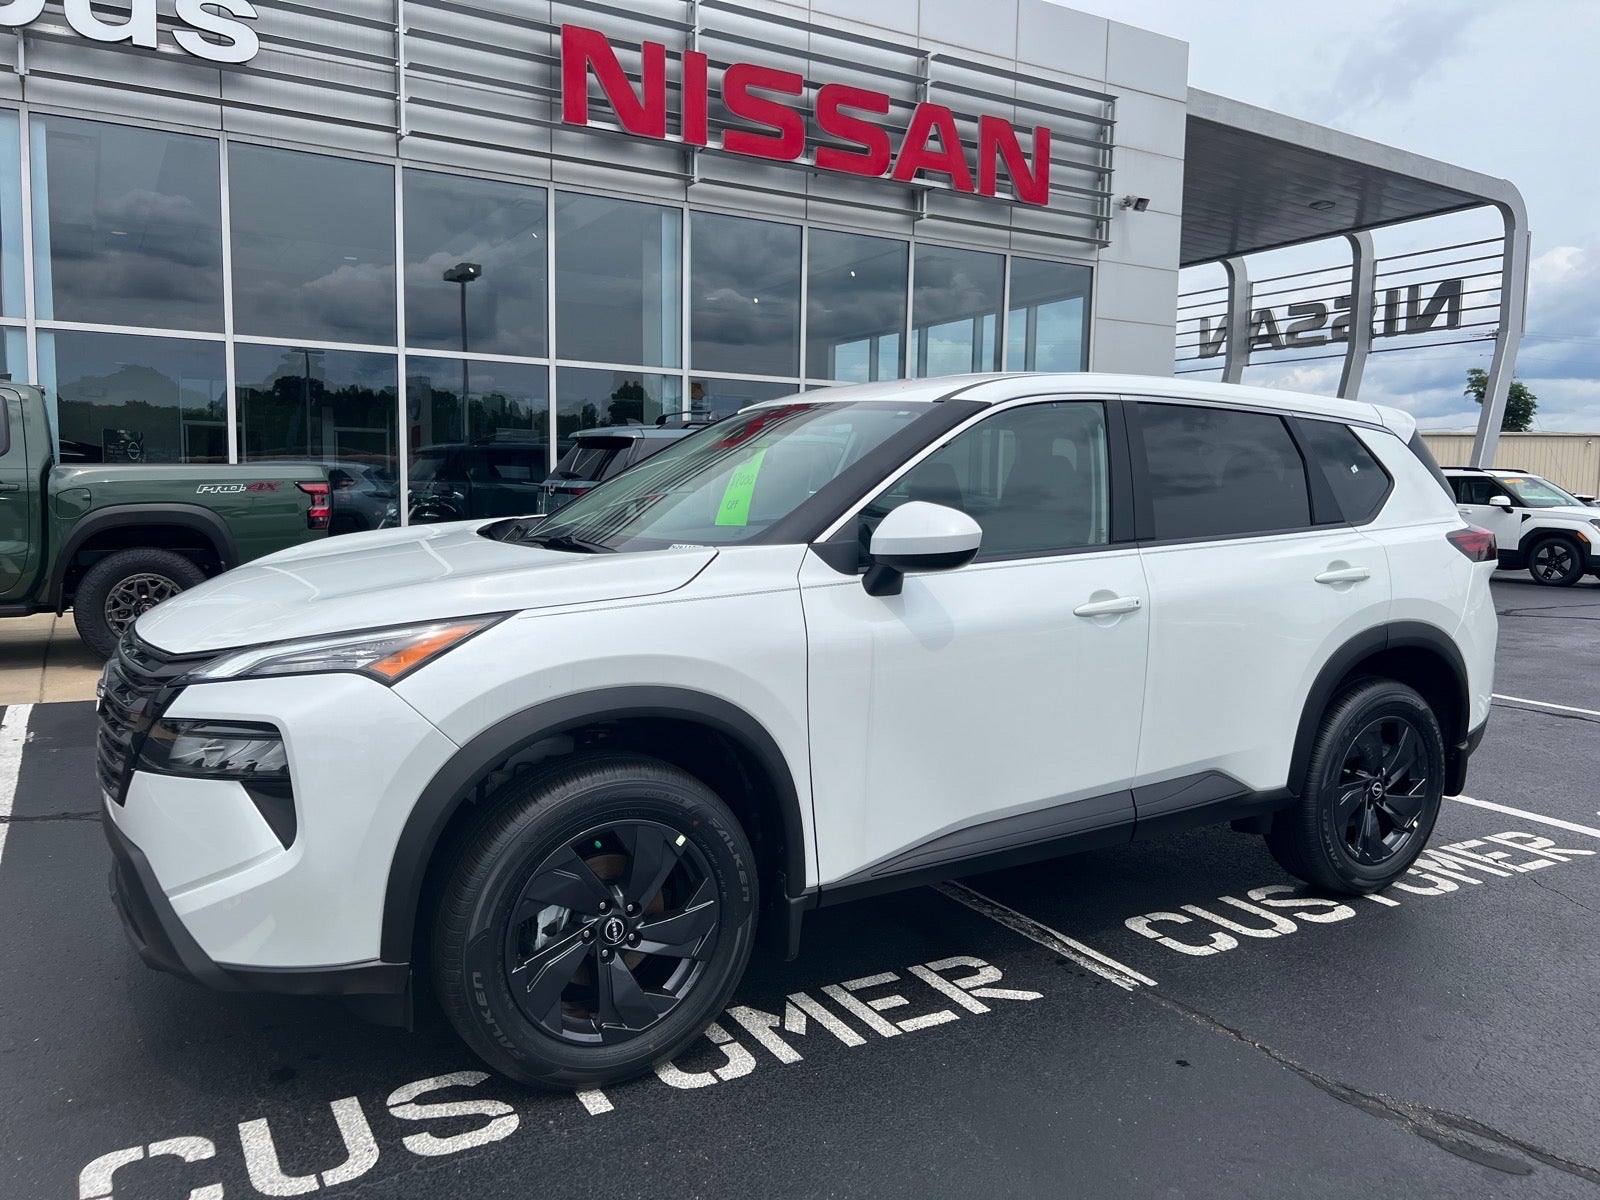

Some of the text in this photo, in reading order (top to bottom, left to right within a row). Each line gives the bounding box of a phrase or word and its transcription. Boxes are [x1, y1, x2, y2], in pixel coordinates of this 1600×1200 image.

[560, 23, 1051, 206] NISSAN
[1124, 831, 1597, 956] CUSOMER
[77, 955, 1044, 1200] CUSOMER
